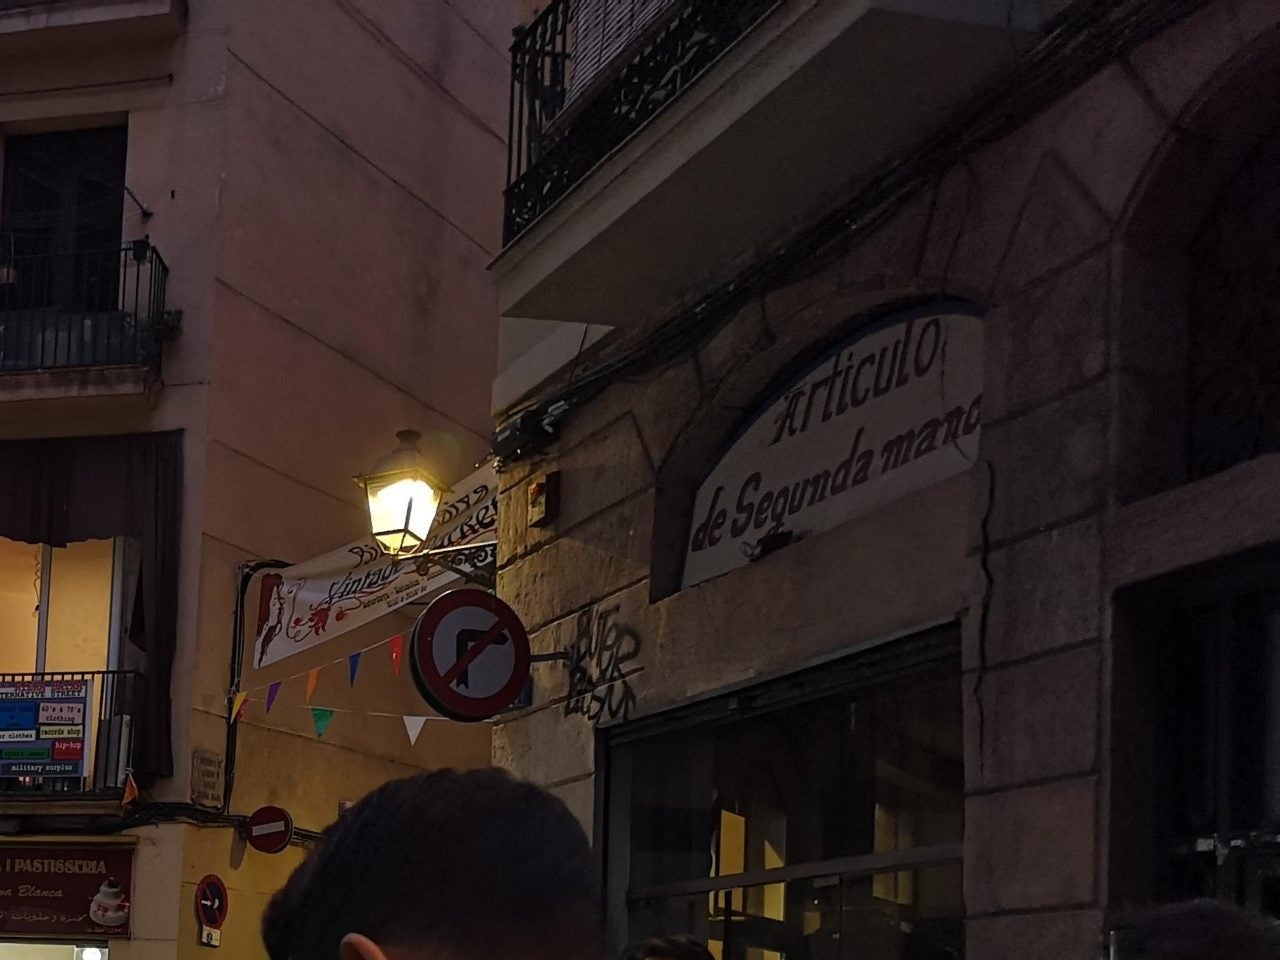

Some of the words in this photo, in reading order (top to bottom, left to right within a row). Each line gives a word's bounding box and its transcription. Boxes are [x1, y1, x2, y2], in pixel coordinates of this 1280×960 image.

[691, 485, 727, 552] de
[730, 426, 874, 539] Segunda
[51, 688, 82, 698] STREET
[46, 715, 75, 723] clothing
[8, 732, 33, 740] clothes
[55, 741, 82, 750] hip-hop
[11, 764, 43, 773] military
[46, 764, 73, 772] surplus
[14, 859, 108, 875] PASTISSERIA
[18, 884, 64, 898] Blanca
